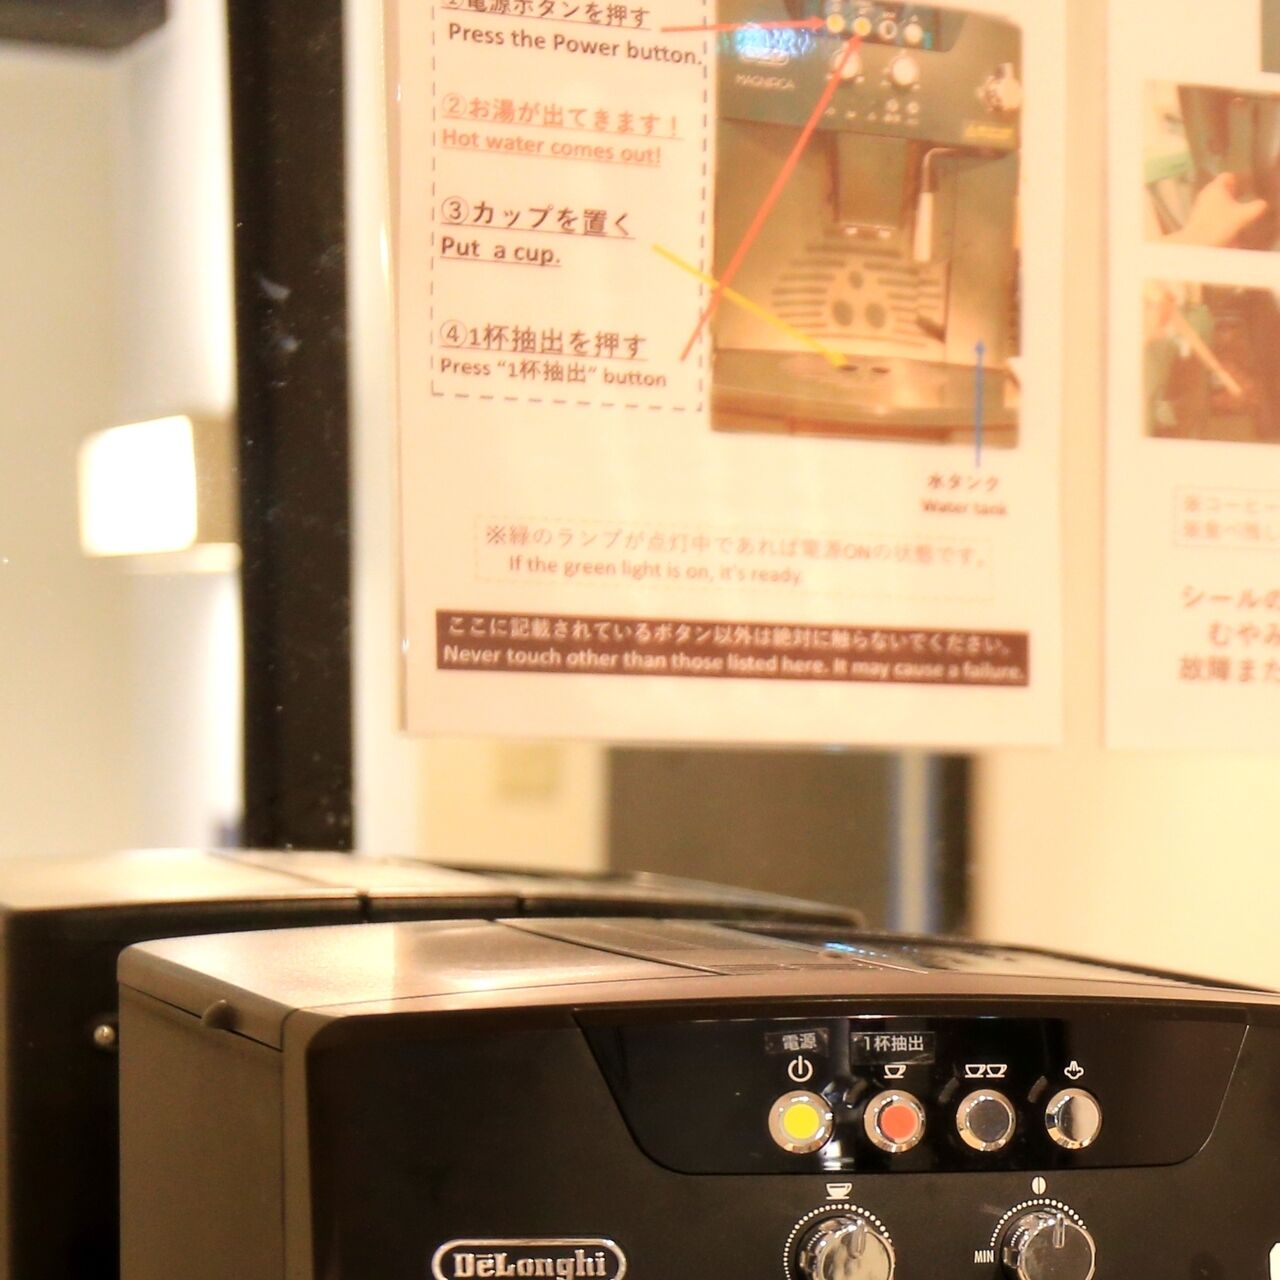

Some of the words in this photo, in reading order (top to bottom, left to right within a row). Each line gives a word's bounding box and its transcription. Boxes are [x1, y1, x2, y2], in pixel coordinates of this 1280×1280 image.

[449, 22, 505, 46] Press
[511, 29, 546, 50] the
[554, 34, 620, 57] Power
[627, 41, 702, 65] button.
[441, 128, 479, 149] Hot
[485, 132, 544, 153] water
[551, 140, 614, 160] comes
[620, 146, 662, 165] out!
[441, 236, 480, 257] Put
[493, 243, 505, 259] a
[514, 246, 561, 266] cup.
[441, 358, 491, 376] Press
[603, 368, 667, 386] button
[921, 499, 967, 514] Water
[509, 554, 523, 572] If
[527, 557, 558, 573] the
[564, 561, 615, 579] green
[622, 559, 661, 580] light
[666, 562, 679, 577] is
[686, 564, 714, 582] on,
[443, 645, 500, 664] Never
[507, 647, 561, 667] touch
[566, 649, 618, 668] other
[623, 651, 666, 670] than
[671, 652, 723, 672] those
[727, 654, 777, 673] listed
[782, 656, 829, 674] here.
[833, 658, 847, 675] It
[851, 662, 889, 680] may
[894, 662, 943, 677] cause
[947, 665, 958, 679] a
[962, 661, 1024, 681] failure.
[782, 1032, 818, 1051] 電源
[863, 1034, 924, 1053] 1杯抽出
[974, 1250, 994, 1264] MIN
